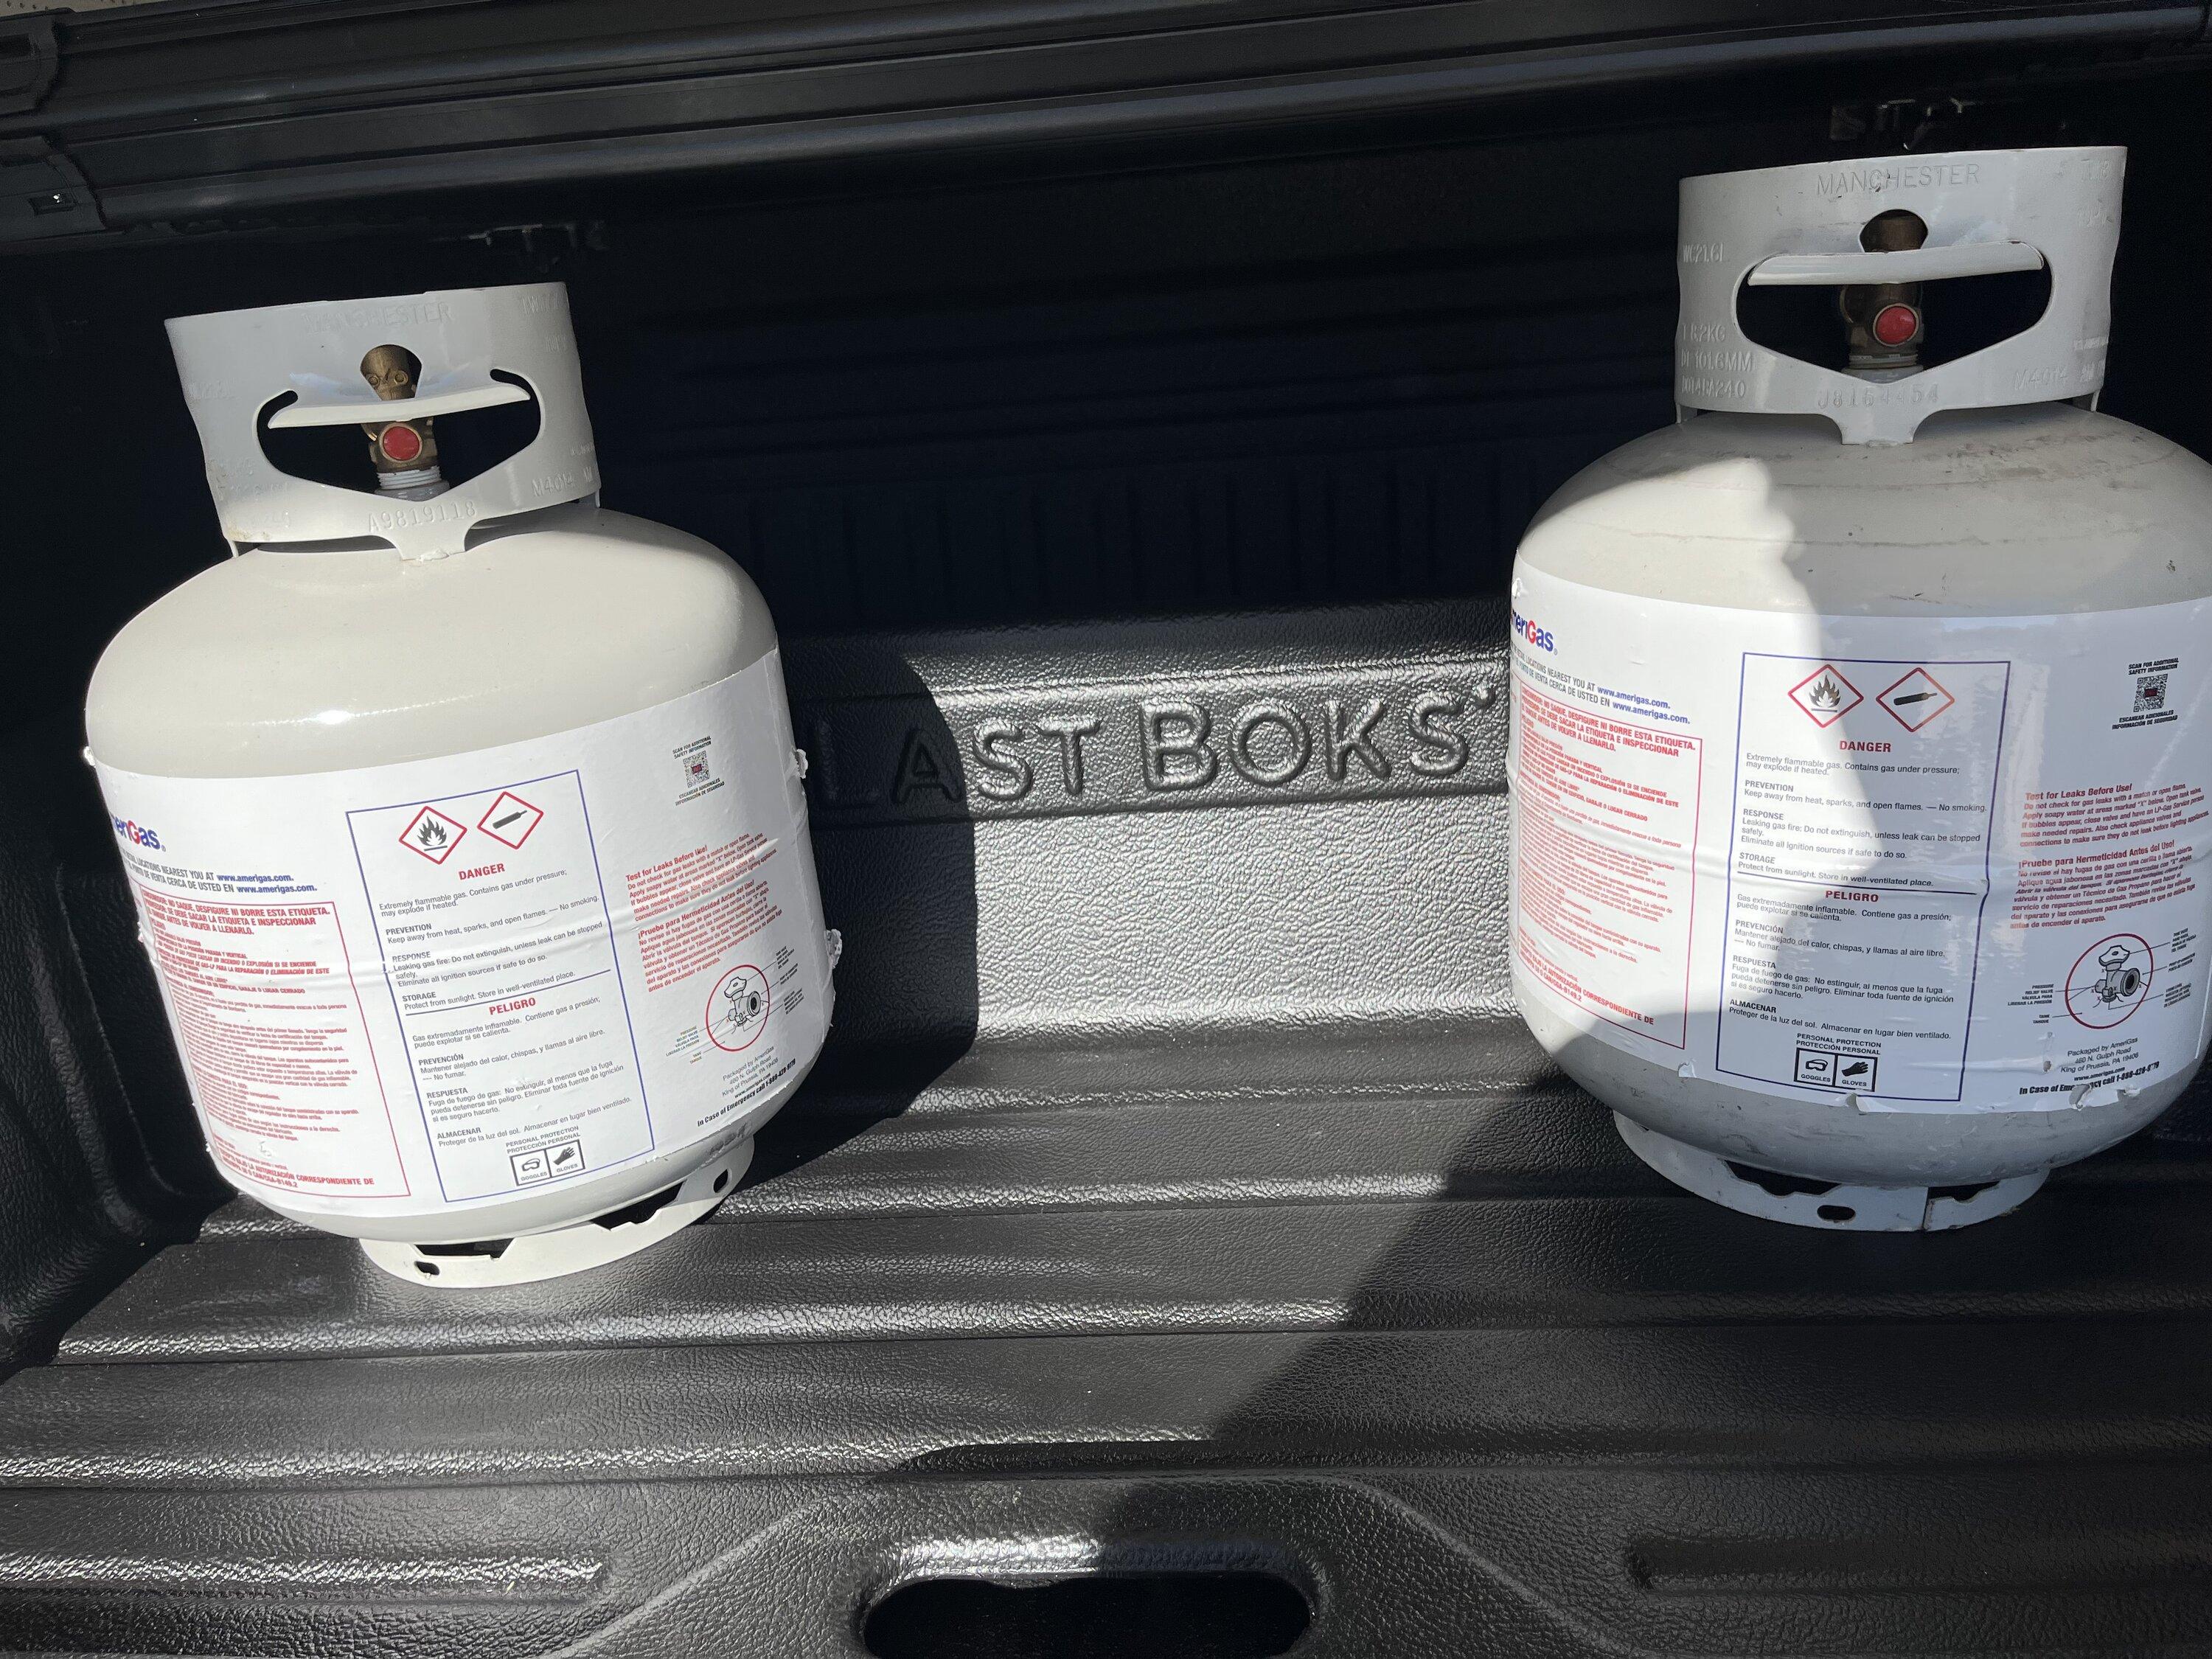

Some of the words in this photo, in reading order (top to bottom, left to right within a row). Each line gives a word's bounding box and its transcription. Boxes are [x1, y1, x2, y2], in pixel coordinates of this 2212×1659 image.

[1817, 164, 1980, 195] MANCHESTER
[369, 500, 477, 532] A9819118
[1547, 667, 1571, 684] NEAREST
[1573, 676, 1585, 689] YOU
[1586, 681, 1595, 692] AT
[1597, 686, 1670, 708] www.amerigas.com.
[1139, 691, 1469, 792] BOKS
[1840, 740, 1891, 752] DANGER
[2060, 790, 2085, 798] Leaks
[2087, 787, 2113, 796] Before
[2115, 784, 2132, 792] Use!
[625, 871, 641, 882] Test
[641, 868, 652, 877] for
[653, 860, 672, 872] Leaks
[674, 852, 694, 865] Before
[695, 844, 707, 856] Use!
[216, 874, 293, 883] www.amerigas.com.
[459, 863, 505, 880] DANGER
[236, 884, 317, 894] www.amerigas.com.
[378, 900, 414, 910] Extremely
[414, 894, 451, 905] flammable
[453, 891, 467, 900] gas.
[468, 885, 499, 896] Contains
[500, 882, 513, 891] gas
[514, 877, 535, 886] under
[535, 869, 567, 883] pressure;
[1825, 890, 1879, 902] PELIGRO
[397, 905, 424, 915] explode
[431, 900, 458, 909] heated.
[1736, 894, 1750, 902] Gas
[1752, 897, 1813, 911] extremadamente
[1815, 905, 1857, 915] inflamable.
[1861, 909, 1895, 918] Contiene
[1920, 913, 1951, 921] presión;
[444, 927, 462, 936] heat,
[463, 922, 489, 933] sparks,
[489, 918, 503, 927] and
[504, 915, 521, 925] open
[522, 909, 547, 919] flames.
[569, 895, 599, 908] smoking.
[385, 923, 431, 935] PREVENTION
[1735, 919, 1784, 933] PREVENCIÓN
[393, 962, 421, 971] Leaking
[422, 960, 435, 969] gas
[436, 956, 450, 965] fire:
[462, 952, 474, 960] not
[475, 945, 513, 958] extinguish,
[513, 940, 537, 950] unless
[537, 934, 552, 944] leak
[576, 921, 603, 934] stopped
[392, 951, 431, 962] RESPONSE
[1732, 955, 1777, 968] RESPUESTA
[395, 971, 417, 979] safely.
[402, 991, 436, 1001] STORAGE
[404, 1001, 428, 1010] Protect
[447, 992, 476, 1004] sunlight.
[476, 990, 496, 998] Store
[504, 975, 554, 992] well-ventilated
[555, 972, 575, 982] place.
[488, 997, 536, 1015] PELIGRO
[1729, 998, 1777, 1012] ALMACENAR
[1728, 1006, 1758, 1018] Proteger
[1778, 1015, 1790, 1023] luz
[1790, 1018, 1803, 1026] del
[1820, 1022, 1861, 1033] Almacenar
[1874, 1028, 1894, 1037] lugar
[1795, 1040, 1840, 1050] PROTECCIÓN
[1842, 1046, 1881, 1055] PERSONAL
[1796, 1033, 1834, 1043] PERSONAL
[1836, 1037, 1881, 1048] PROTECTION
[1800, 1074, 1831, 1082] GOGGLES
